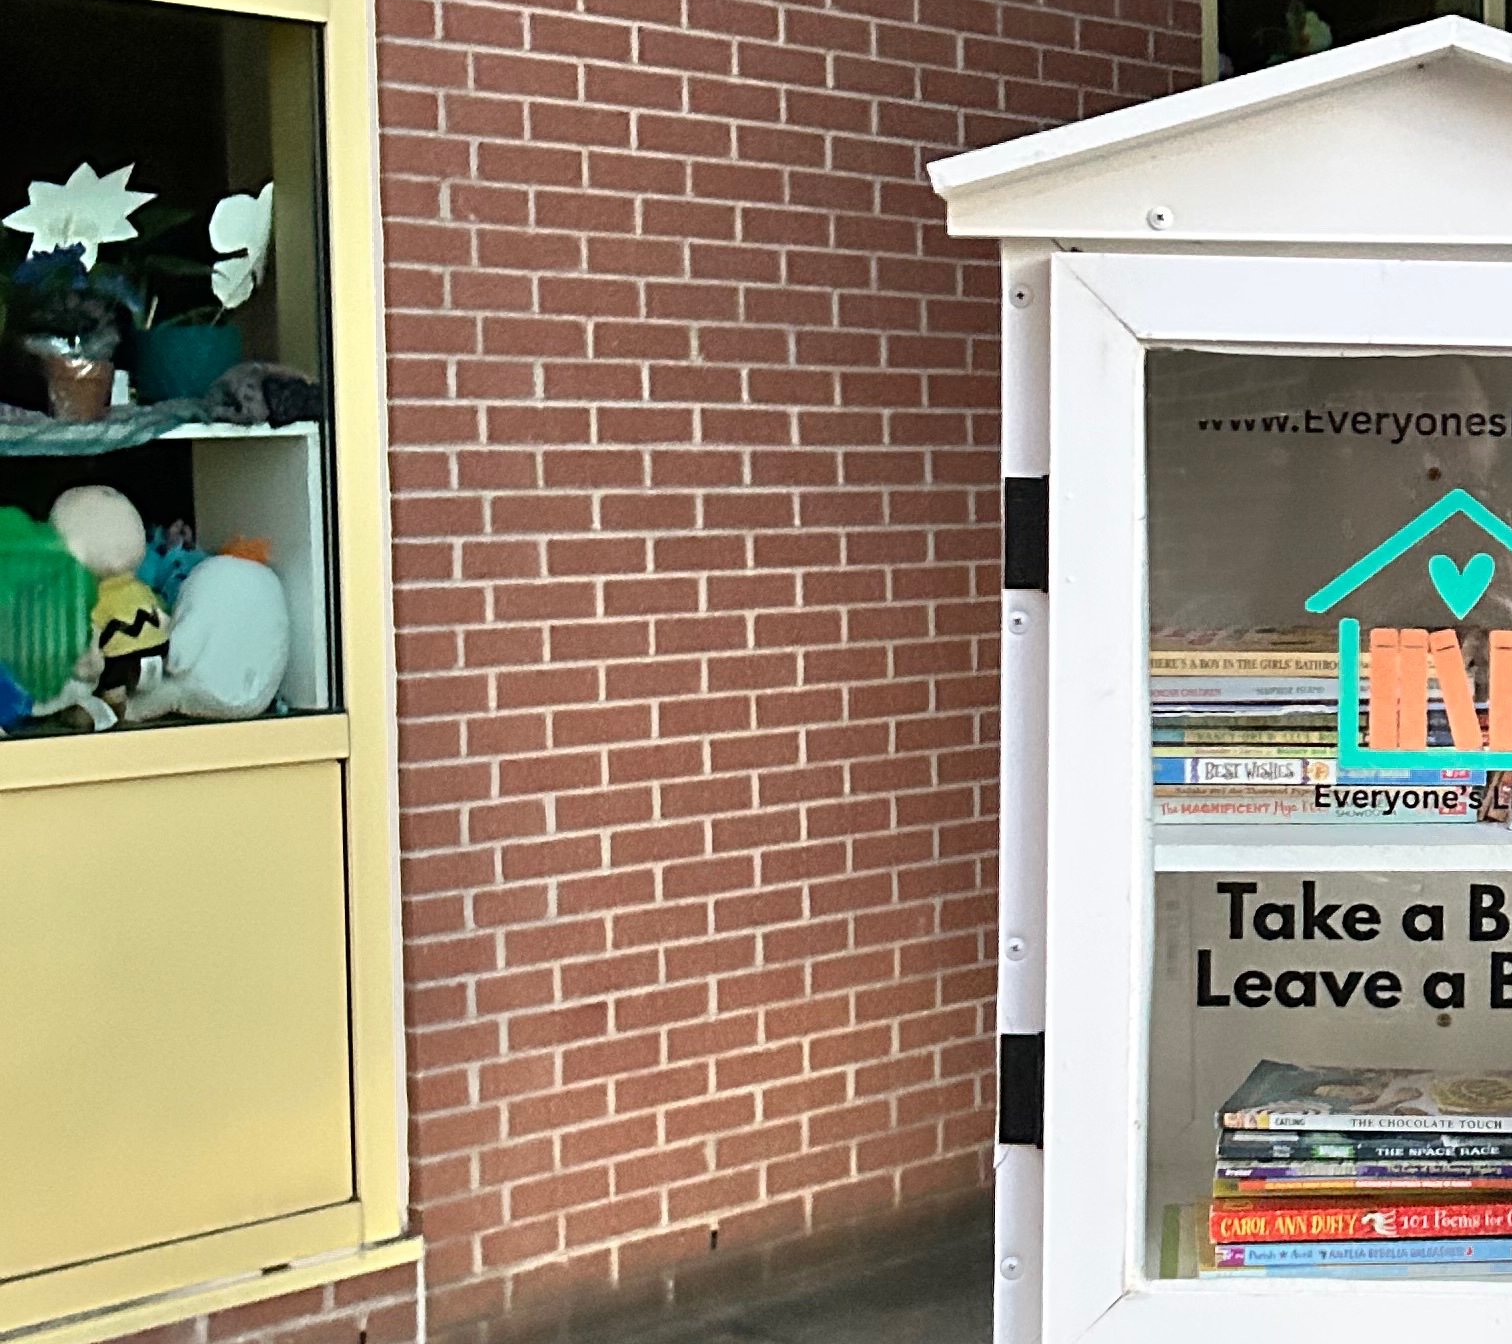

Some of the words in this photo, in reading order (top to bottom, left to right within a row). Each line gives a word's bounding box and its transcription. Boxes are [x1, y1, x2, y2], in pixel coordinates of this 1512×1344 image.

[1151, 658, 1187, 670] HERE'S
[1190, 658, 1198, 670] A
[1200, 658, 1220, 670] BOY
[1223, 658, 1234, 670] IN
[1237, 658, 1257, 670] THE
[1295, 659, 1339, 671] BATHRO
[1205, 762, 1244, 780] BEST
[1245, 762, 1294, 780] WISHES
[1160, 802, 1178, 816] The
[1181, 803, 1271, 815] MAGNIFICENT
[1315, 784, 1483, 816] Everyone's
[1217, 881, 1382, 941] Take
[1402, 904, 1444, 941] a
[1196, 949, 1403, 1008] Leave
[1423, 972, 1465, 1009] a
[1352, 1118, 1374, 1128] THE
[1379, 1118, 1454, 1129] CHOCOLATE
[1459, 1119, 1503, 1130] TOUCH
[1375, 1147, 1404, 1157] THE
[1408, 1146, 1456, 1157] SPACE
[1460, 1146, 1501, 1156] RACE
[1220, 1216, 1270, 1237] CAROL
[1275, 1215, 1307, 1235] ANN
[1312, 1213, 1358, 1235] DUFFY
[1401, 1215, 1429, 1230] 101
[1434, 1210, 1481, 1229] Poems
[1485, 1210, 1502, 1227] for
